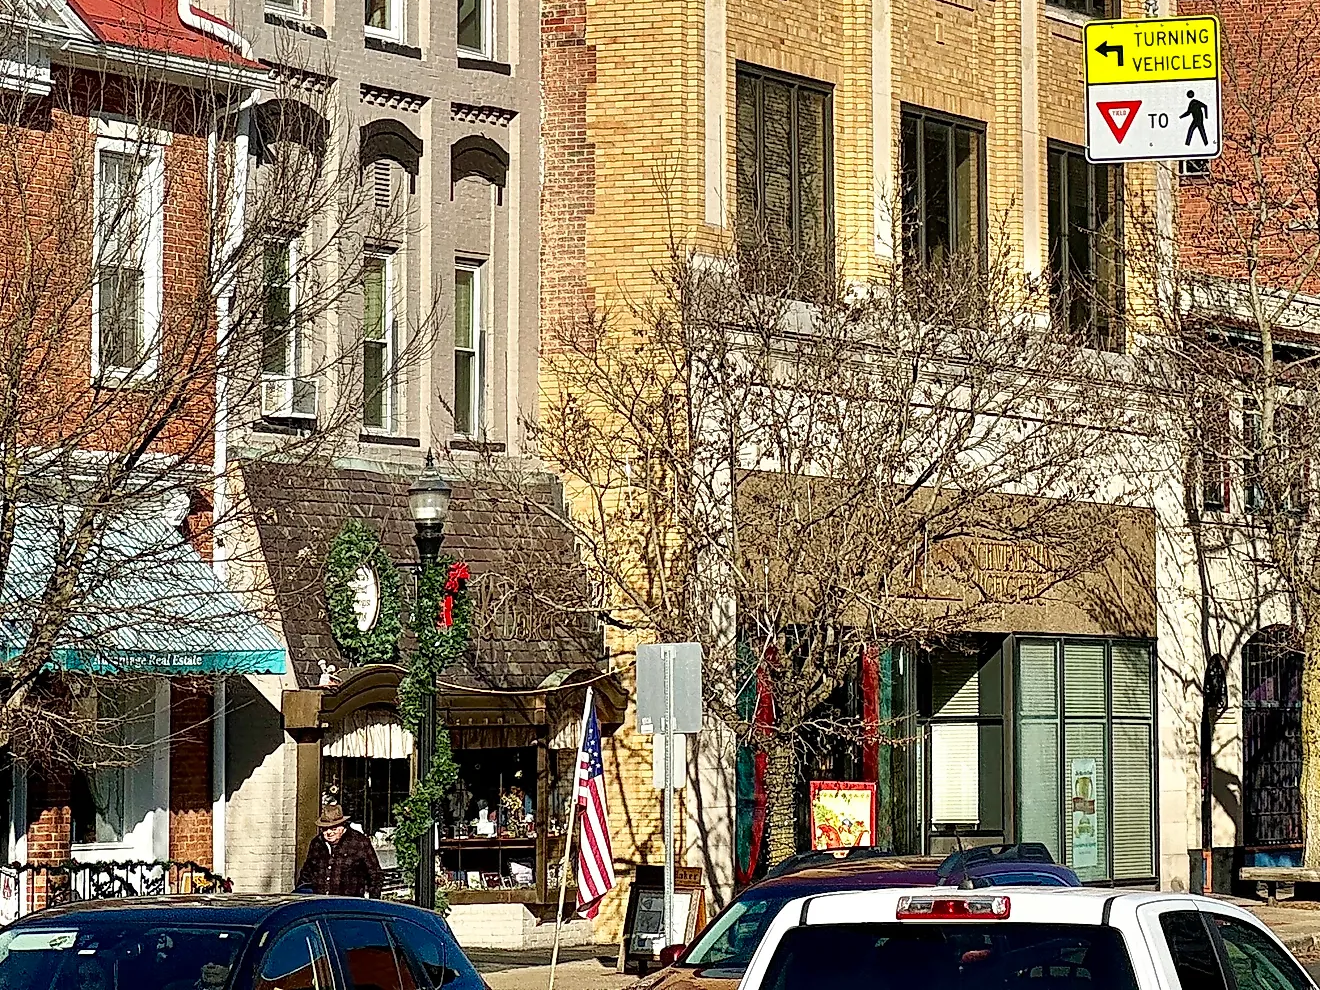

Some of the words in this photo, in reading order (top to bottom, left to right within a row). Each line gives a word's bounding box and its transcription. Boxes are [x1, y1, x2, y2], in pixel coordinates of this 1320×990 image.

[1133, 28, 1210, 48] TURNING
[1132, 53, 1213, 72] VEHICLES
[1148, 113, 1169, 129] TO
[149, 653, 170, 666] Real
[172, 653, 203, 666] Estate
